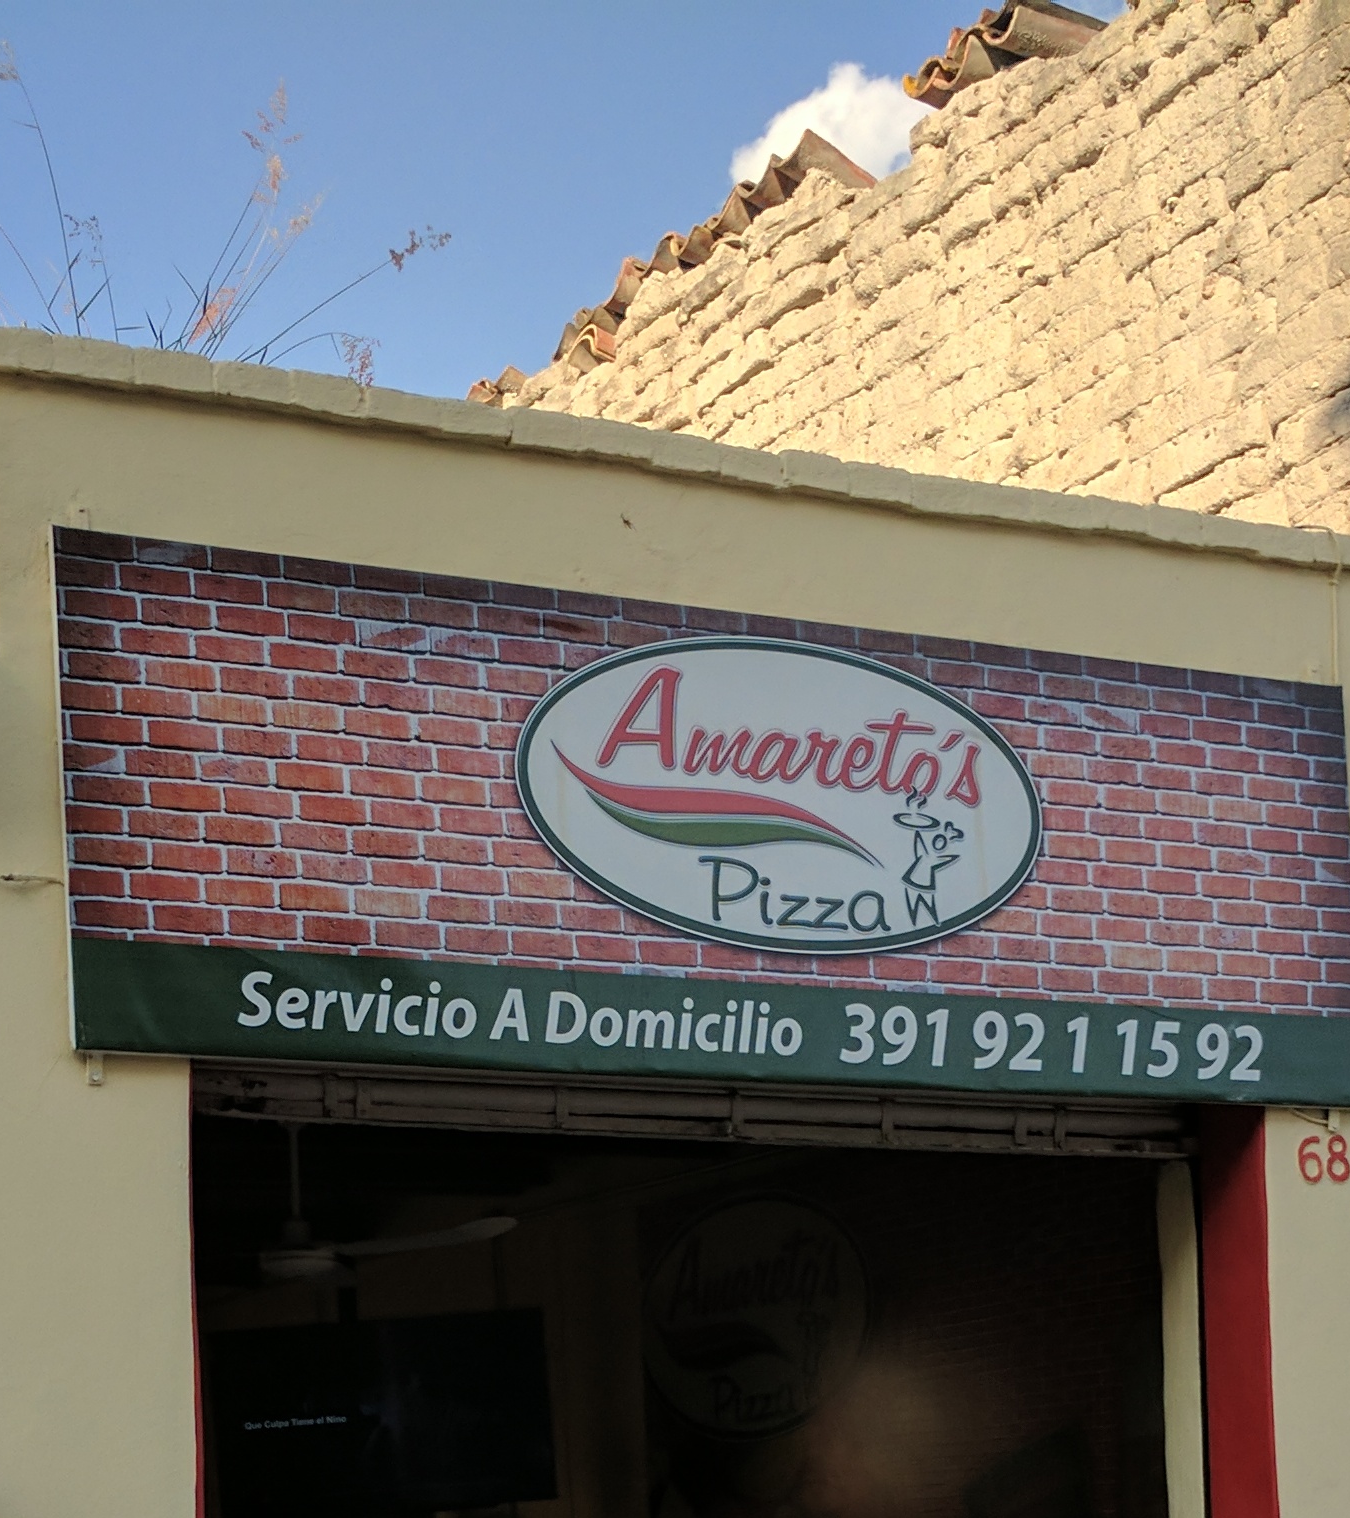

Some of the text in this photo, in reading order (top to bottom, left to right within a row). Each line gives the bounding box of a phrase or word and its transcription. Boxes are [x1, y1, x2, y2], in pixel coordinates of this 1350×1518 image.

[595, 664, 982, 808] Amareto's
[698, 855, 892, 933] Pizza
[237, 971, 478, 1039] Servicio
[490, 987, 531, 1042] A
[544, 990, 803, 1056] Domicilio
[838, 1003, 950, 1068] 391
[972, 1010, 1046, 1072] 92
[1116, 1019, 1181, 1078] 15
[1195, 1022, 1264, 1082] 92
[1297, 1134, 1350, 1184] 68
[244, 1421, 262, 1430] Que
[316, 1416, 324, 1424] el
